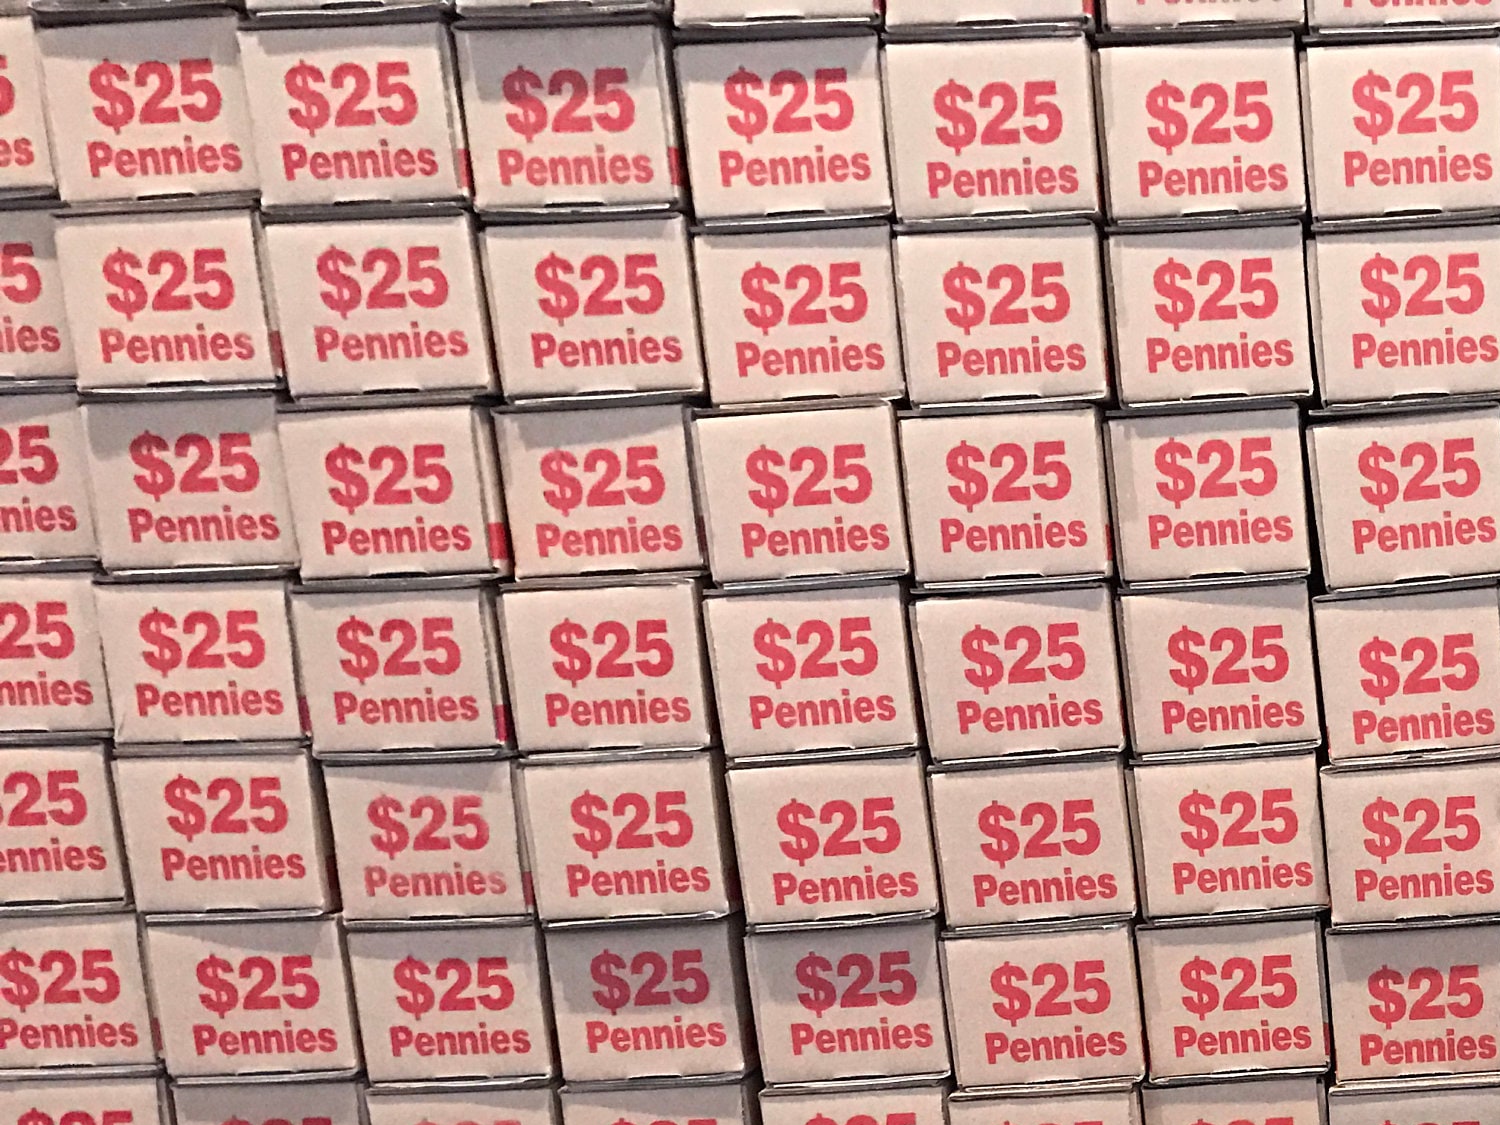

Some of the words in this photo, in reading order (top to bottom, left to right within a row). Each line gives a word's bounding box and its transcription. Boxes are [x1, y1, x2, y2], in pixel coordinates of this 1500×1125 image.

[502, 67, 636, 143] $25
[933, 79, 1063, 156] $25
[1352, 69, 1479, 145] $25
[497, 145, 655, 187] Pennies
[926, 161, 1079, 199] Pennies
[1343, 146, 1493, 187] Pennies
[316, 246, 449, 319] $25
[741, 261, 869, 336] $25
[1153, 257, 1279, 332] $25
[314, 321, 470, 362] Pennies
[735, 336, 885, 377] Pennies
[1146, 331, 1294, 374] Pennies
[324, 443, 453, 515] $25
[745, 443, 873, 518] $25
[1154, 436, 1278, 510] $25
[321, 516, 473, 556] Pennies
[741, 516, 890, 558] Pennies
[1148, 508, 1294, 550] Pennies
[336, 616, 462, 684] $25
[753, 616, 878, 690] $25
[1167, 624, 1289, 695] $25
[333, 691, 480, 725] Pennies
[749, 688, 896, 730] Pennies
[1161, 694, 1305, 735] Pennies
[0, 769, 88, 828] 25
[1178, 788, 1299, 858] $25
[366, 794, 490, 860] $25
[776, 796, 902, 867] $25
[0, 838, 108, 872] ennies
[364, 863, 507, 897] Pennies
[1172, 855, 1314, 895] Pennies
[772, 865, 919, 906] Pennies
[393, 956, 515, 1020] $25
[795, 950, 917, 1019] $25
[1368, 965, 1484, 1031] $25
[389, 1022, 531, 1057] Pennies
[790, 1016, 934, 1056] Pennies
[1359, 1028, 1498, 1066] Pennies
